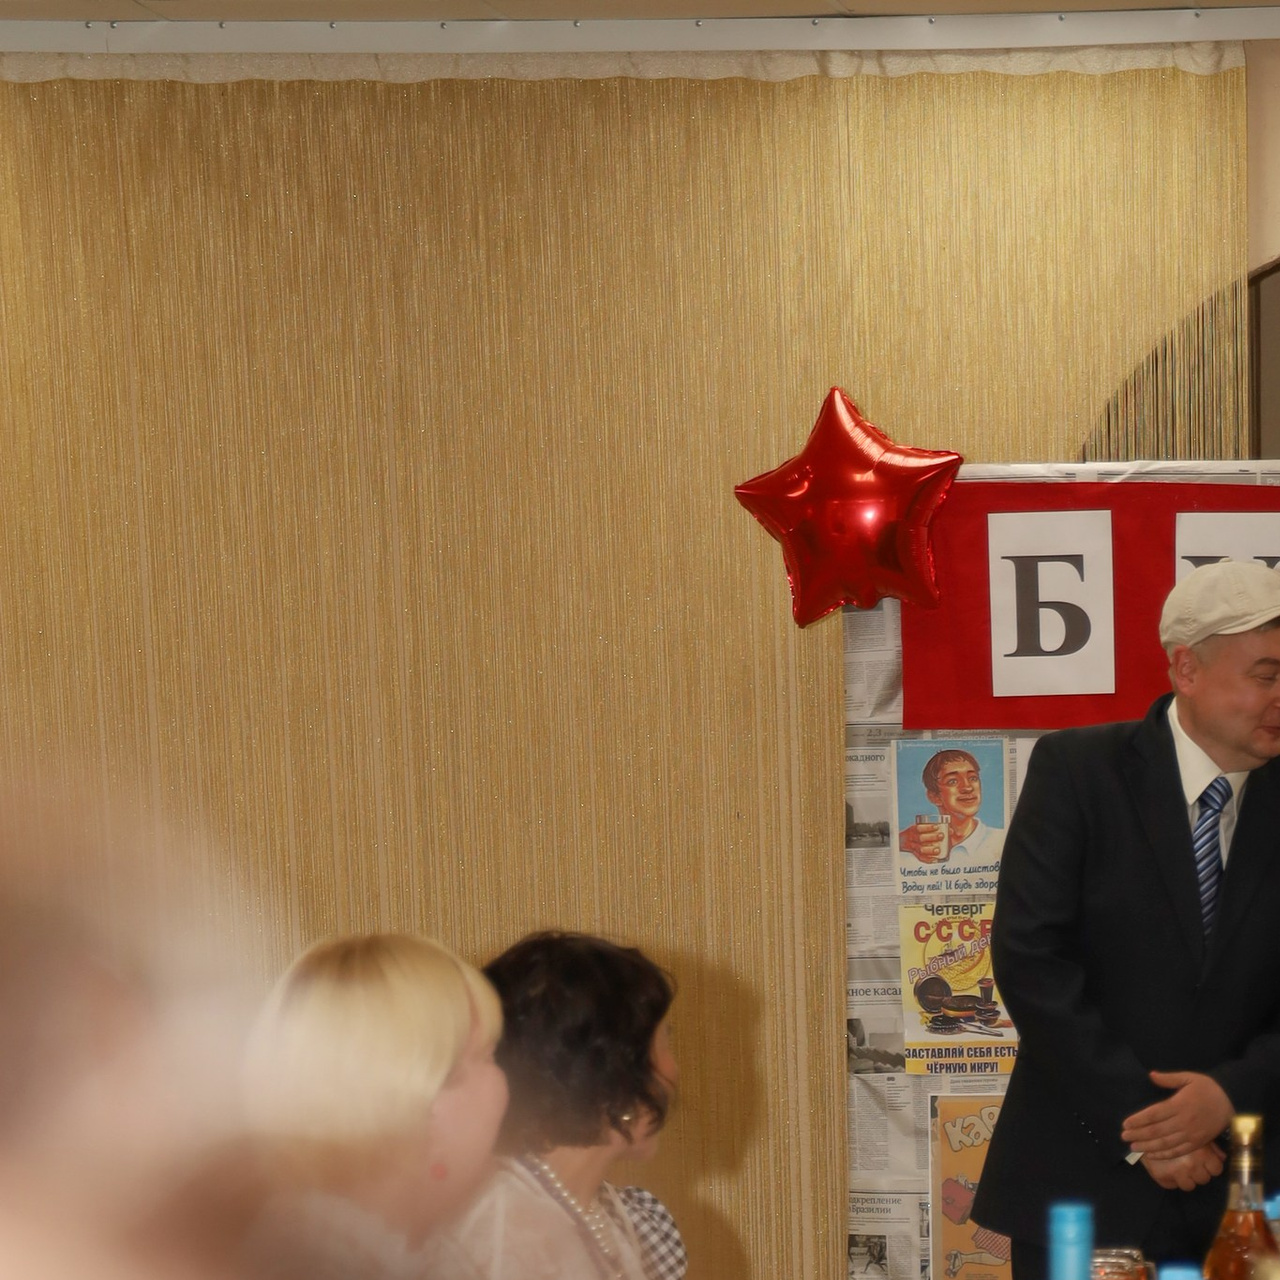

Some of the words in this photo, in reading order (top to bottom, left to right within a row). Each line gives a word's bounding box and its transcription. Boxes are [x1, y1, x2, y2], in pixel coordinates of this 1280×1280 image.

[900, 866, 928, 877] Чтобы
[930, 868, 939, 876] не
[941, 864, 961, 875] было
[902, 881, 925, 894] Водку
[975, 878, 999, 891] здоро
[924, 903, 986, 918] Четверг
[905, 1046, 965, 1059] ЗАСТАВЛЯЙ
[966, 1046, 992, 1058] СЕБЯ
